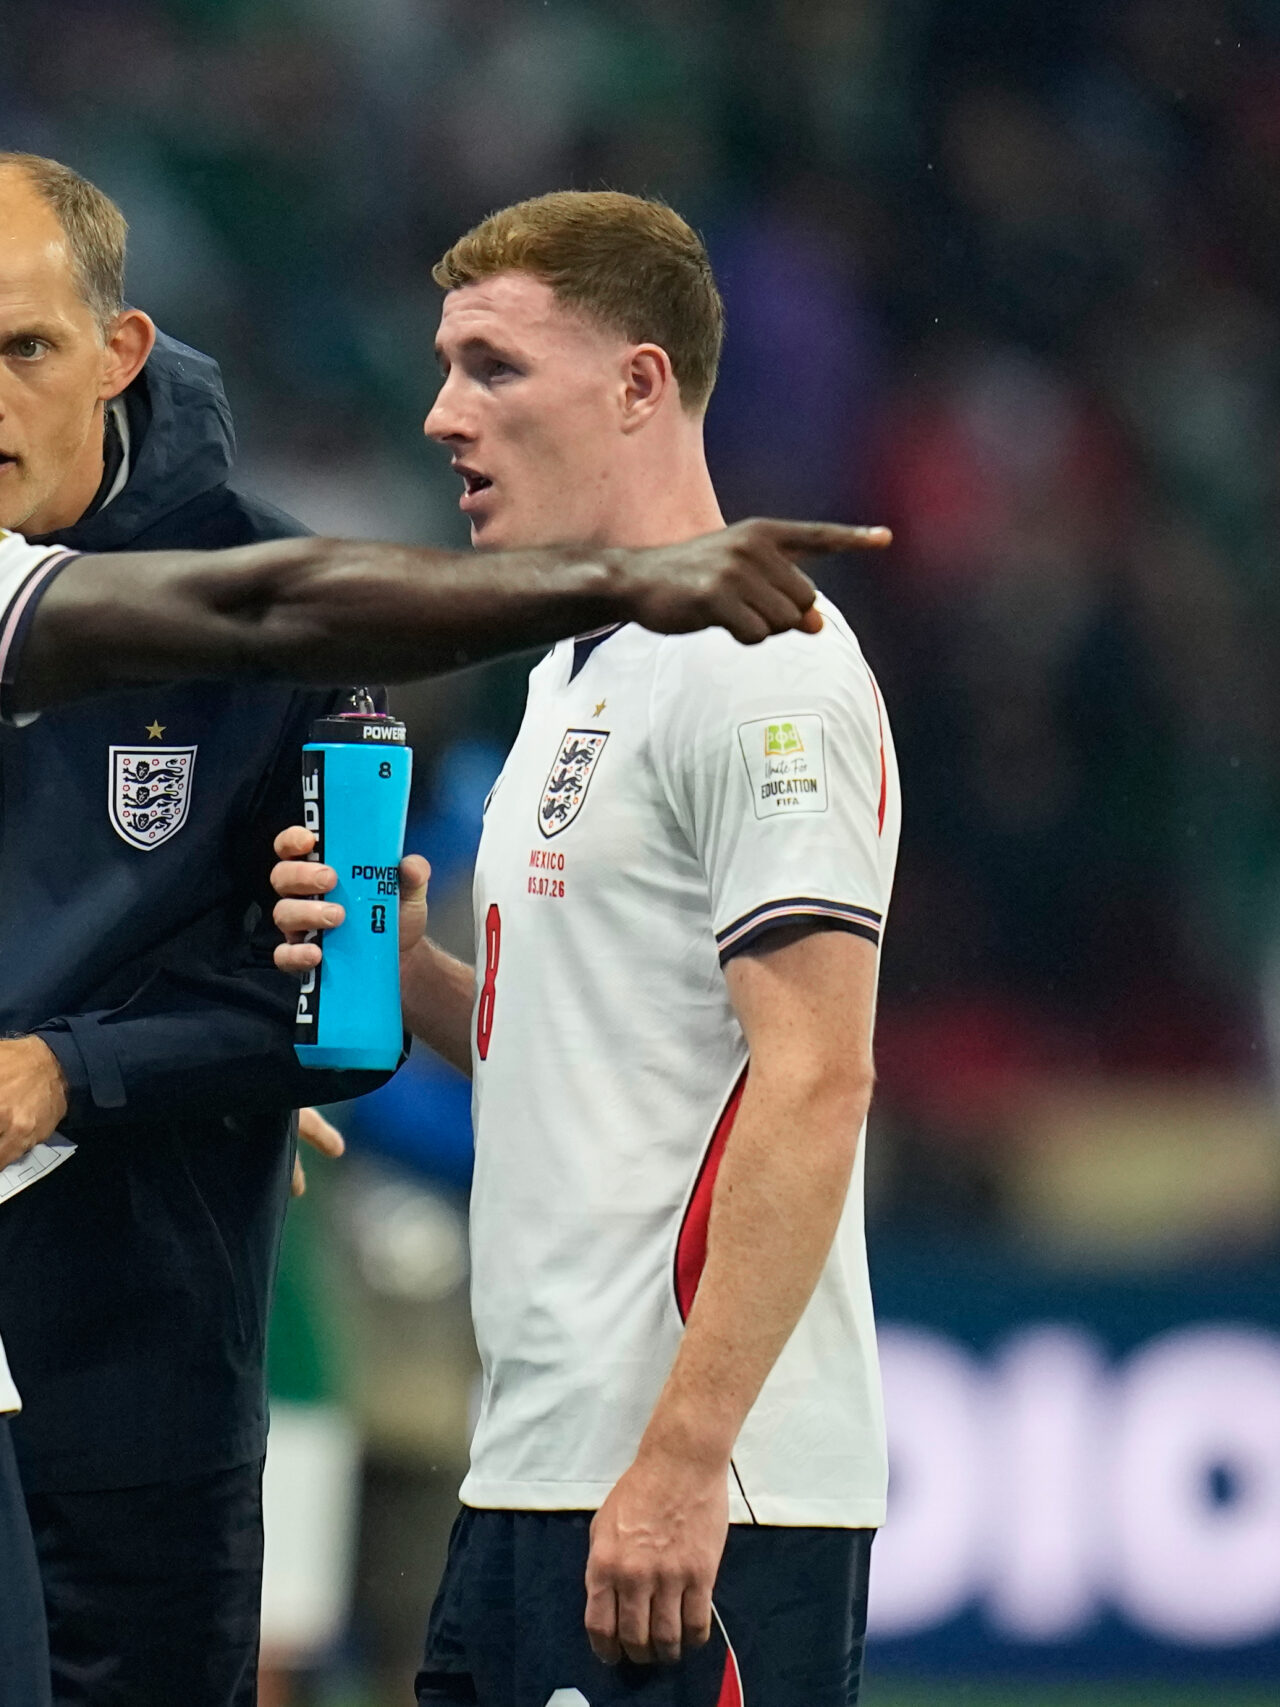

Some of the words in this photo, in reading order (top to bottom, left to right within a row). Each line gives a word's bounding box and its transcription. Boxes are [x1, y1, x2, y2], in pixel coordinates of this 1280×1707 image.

[378, 761, 392, 779] 8
[761, 779, 818, 800] EDUCATION
[776, 797, 800, 807] FIFA
[529, 850, 566, 871] MEXICO
[528, 877, 566, 898] 05.07.26
[477, 904, 501, 1061] 8
